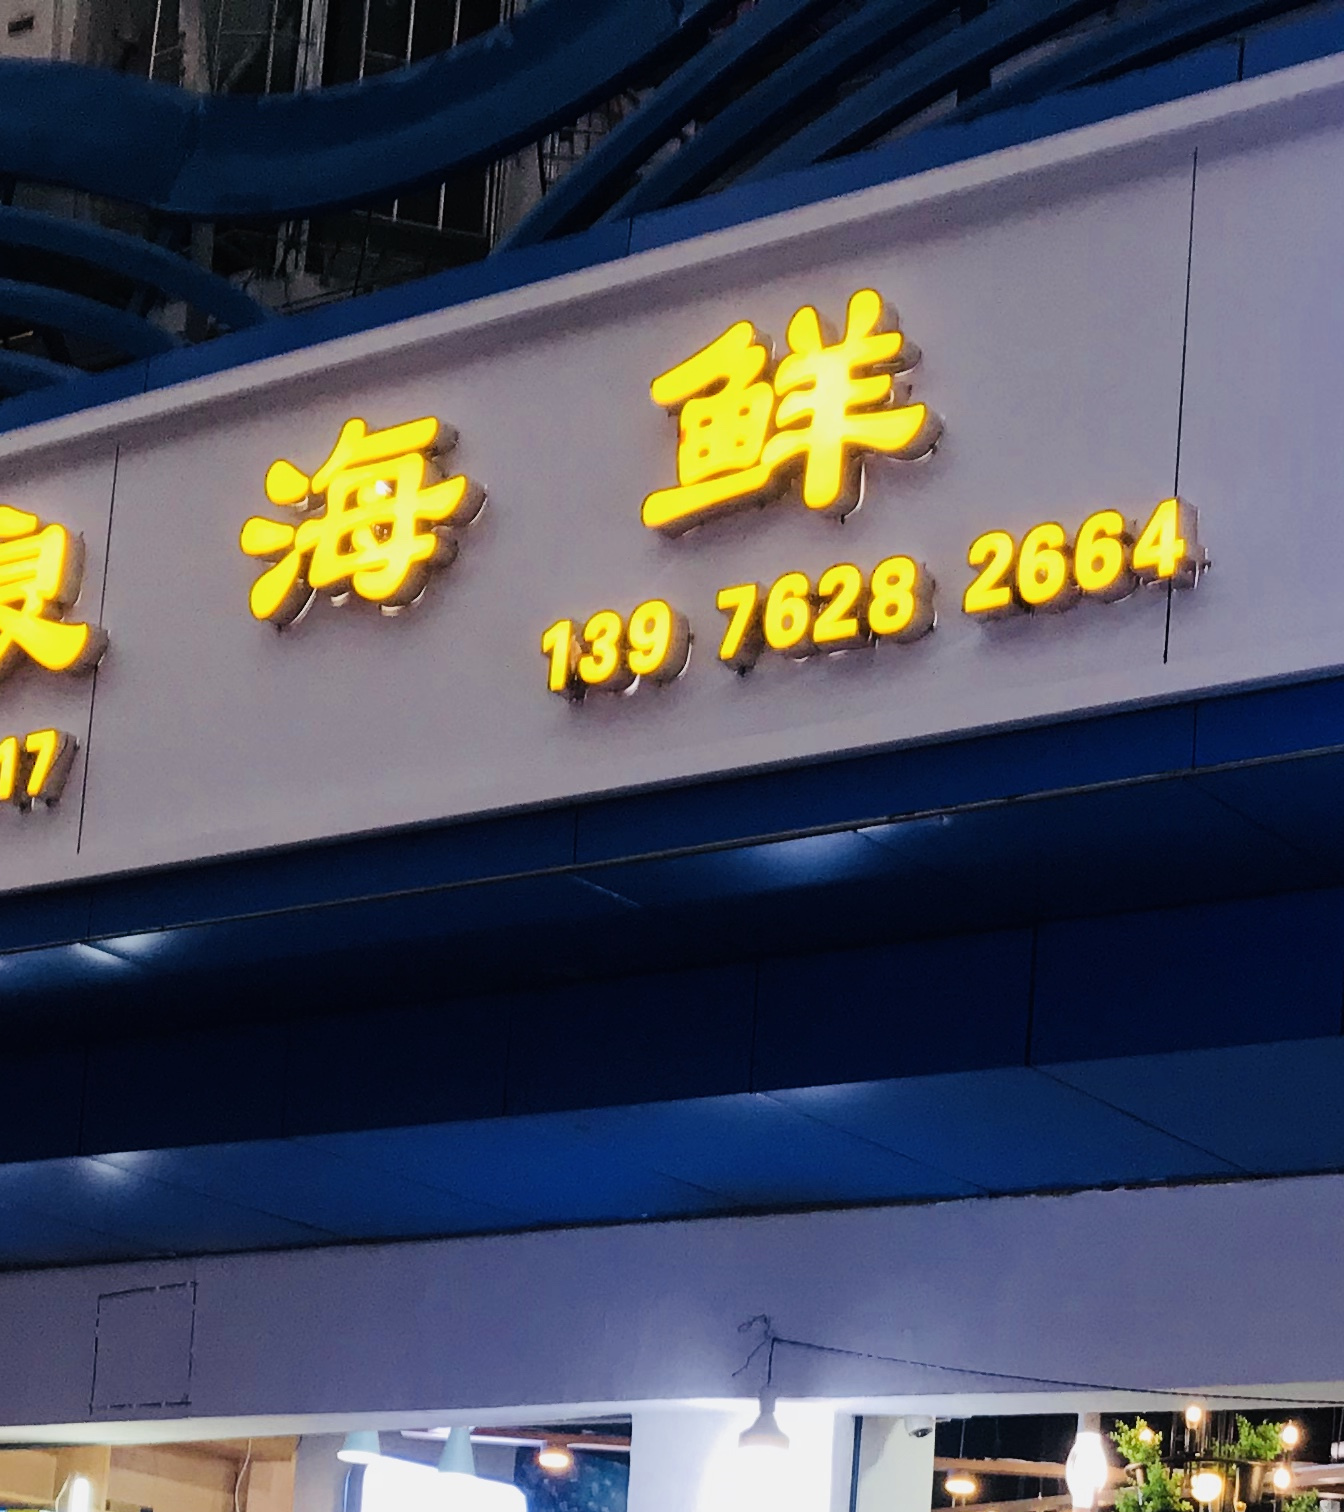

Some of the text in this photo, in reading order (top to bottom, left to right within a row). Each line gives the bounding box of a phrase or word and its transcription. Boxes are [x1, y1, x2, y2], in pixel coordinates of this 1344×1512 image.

[541, 496, 1186, 694] 139 7628 2664
